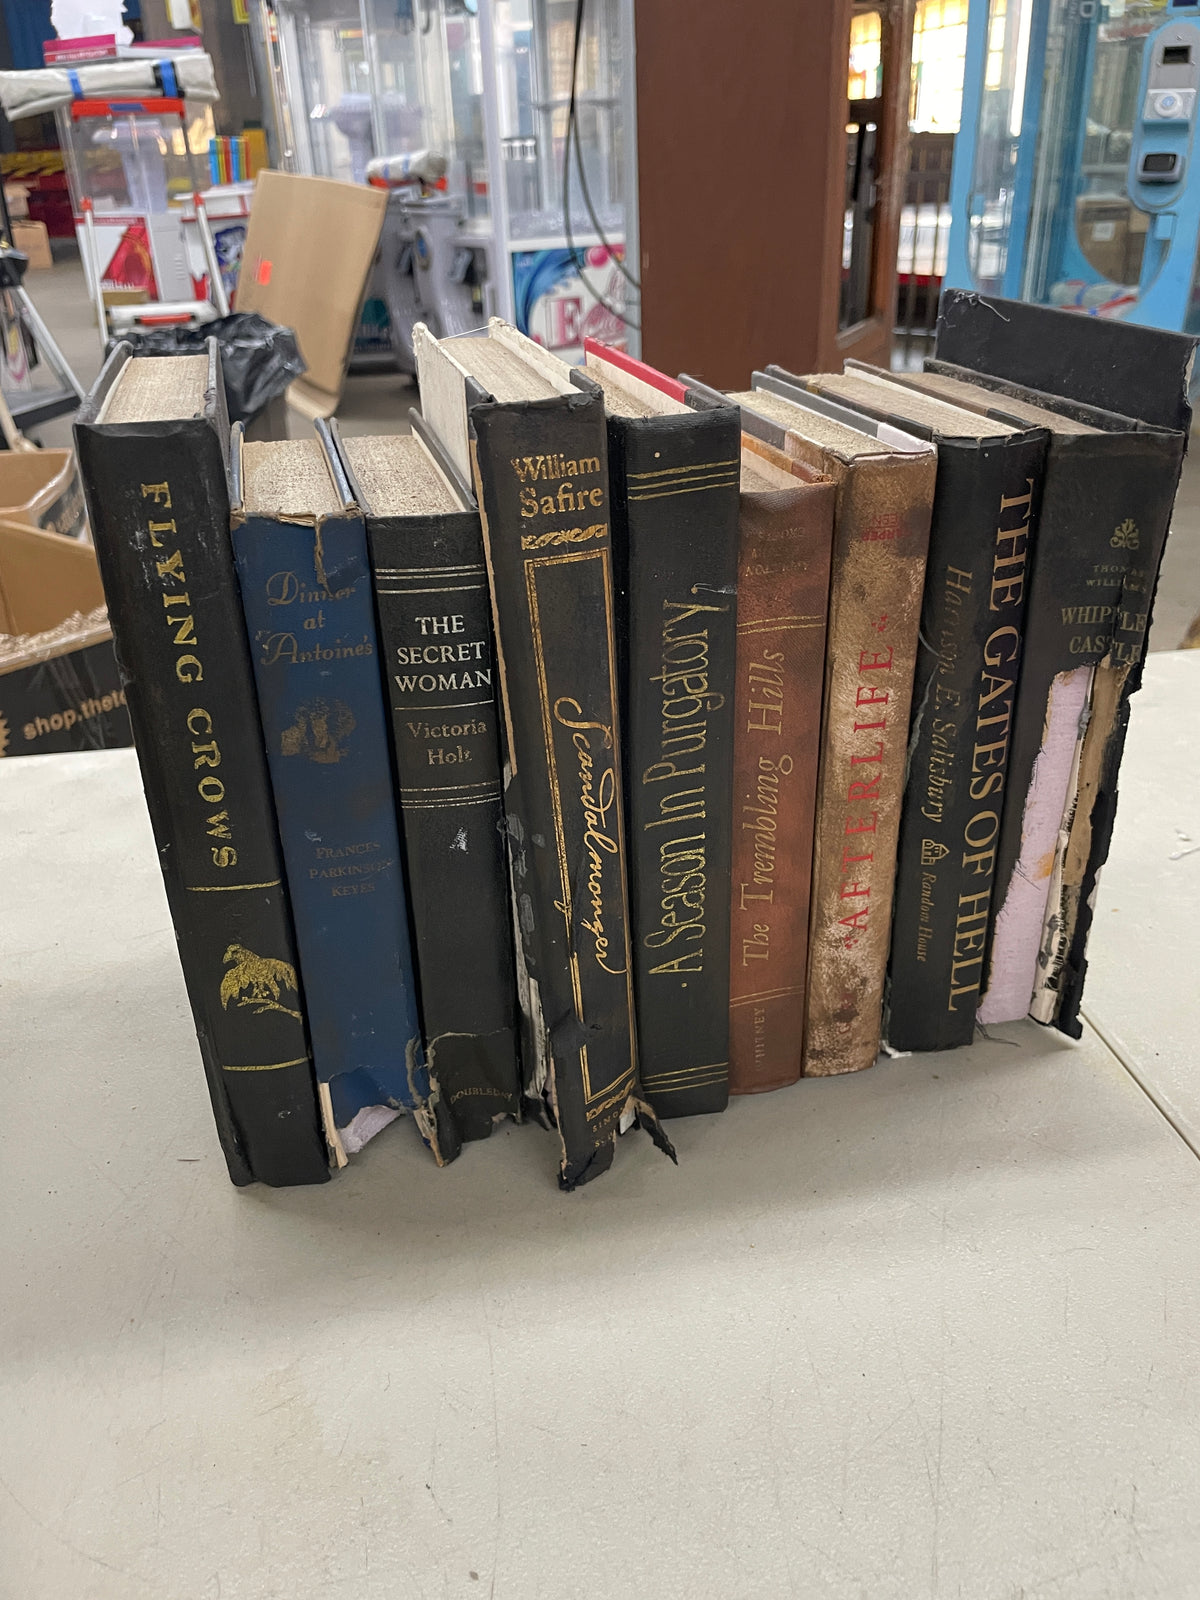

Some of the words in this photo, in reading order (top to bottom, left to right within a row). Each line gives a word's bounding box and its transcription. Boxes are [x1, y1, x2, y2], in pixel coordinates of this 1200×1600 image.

[510, 453, 601, 482] William
[519, 482, 604, 518] Safire
[989, 478, 1034, 612] THE
[141, 481, 204, 683] FLYING
[266, 570, 357, 606] Dinner
[303, 609, 326, 630] at
[415, 614, 466, 637] THE
[261, 632, 374, 665] Antoine's
[397, 641, 486, 666] SECRET
[394, 668, 492, 693] WOMAN
[643, 599, 730, 785] Purgatory
[747, 649, 785, 736] Hills
[934, 682, 962, 711] E.
[406, 718, 488, 740] Victoria
[969, 625, 1019, 801] GATES
[187, 707, 238, 868] CROWS
[837, 645, 894, 932] AFTERLIFE
[921, 717, 958, 824] Salisbury
[643, 786, 706, 831] In
[553, 697, 627, 974] Scandalmonger
[739, 753, 794, 912] Trembling
[962, 810, 1000, 877] OF
[331, 882, 376, 897] KEYES
[643, 832, 707, 948] Season
[919, 872, 937, 923] Random
[649, 948, 704, 974] A
[742, 922, 770, 967] The
[917, 925, 933, 961] House
[948, 886, 992, 1011] HELL
